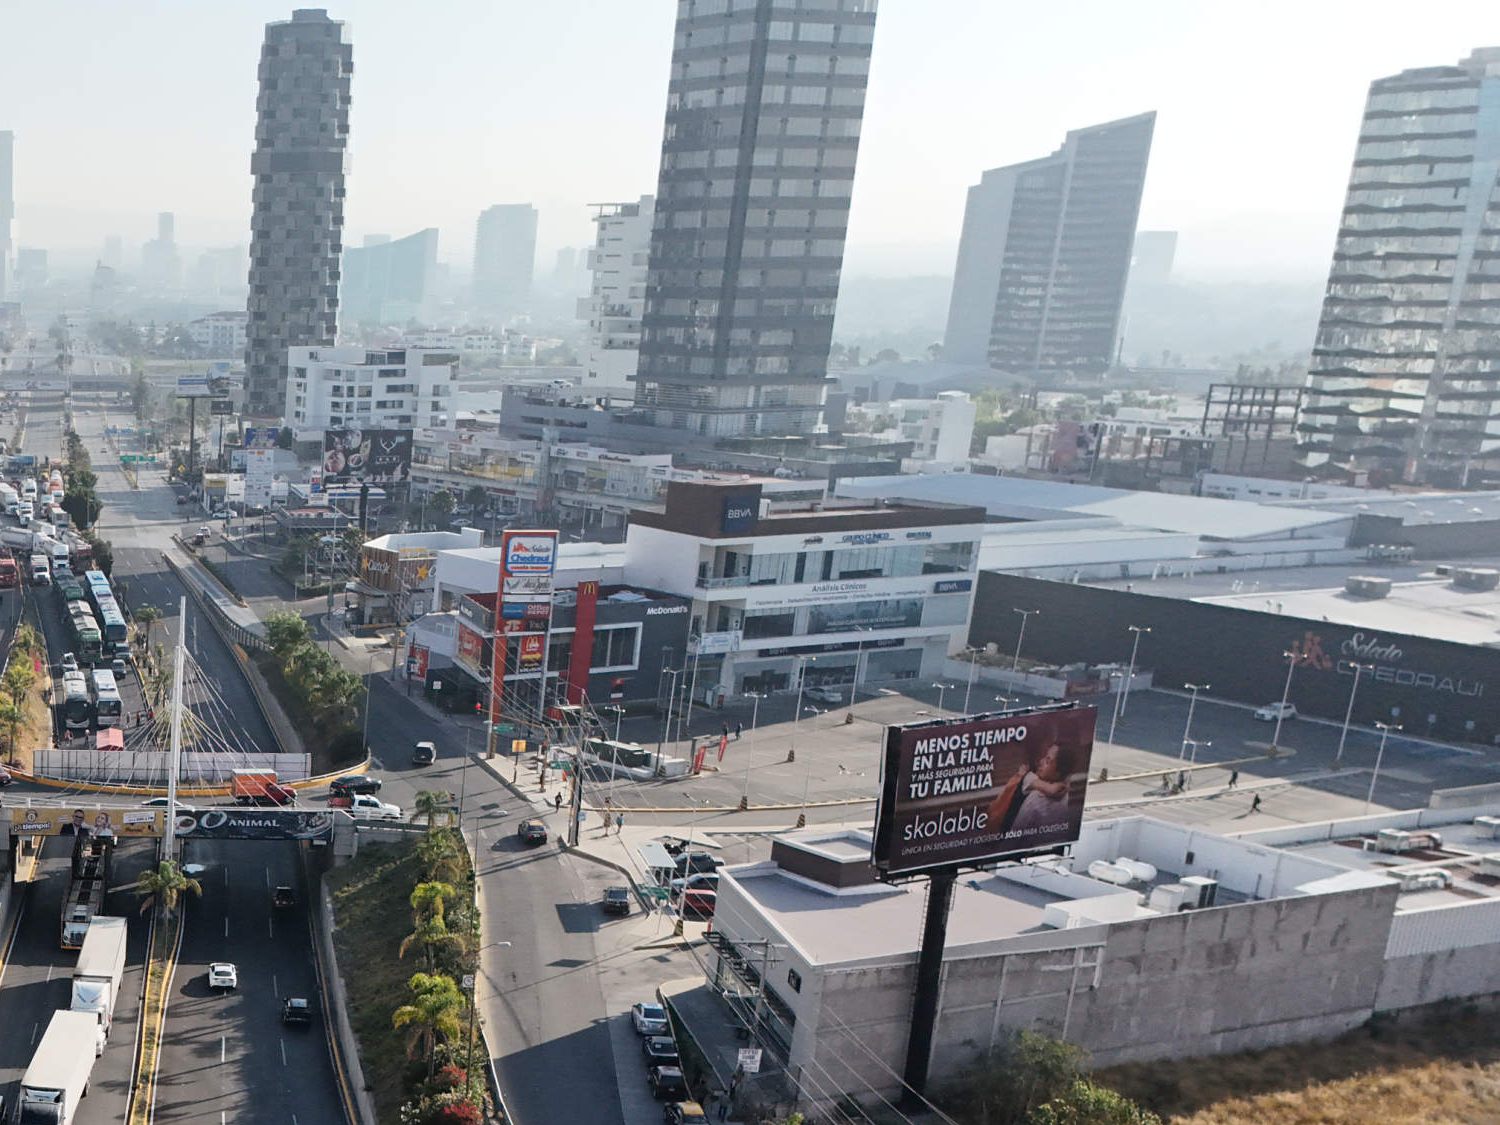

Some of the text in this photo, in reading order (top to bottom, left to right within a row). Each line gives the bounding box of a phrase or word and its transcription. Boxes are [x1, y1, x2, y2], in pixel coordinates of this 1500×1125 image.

[727, 508, 752, 519] BBVA
[510, 554, 550, 563] Chedraui
[646, 605, 688, 615] McDonald's
[1336, 659, 1484, 697] CHEDRAUI
[914, 726, 1027, 756] MENOS TIEMPO
[912, 747, 994, 771] EN LA FILA,
[911, 762, 994, 782] Y MÁS SEGURIDAD PARA
[909, 773, 993, 799] TU FAMILIA
[228, 819, 281, 828] ANIMAL
[903, 805, 989, 841] skolable
[934, 838, 968, 851] SEGURIDAD
[1004, 828, 1023, 840] SÓLO
